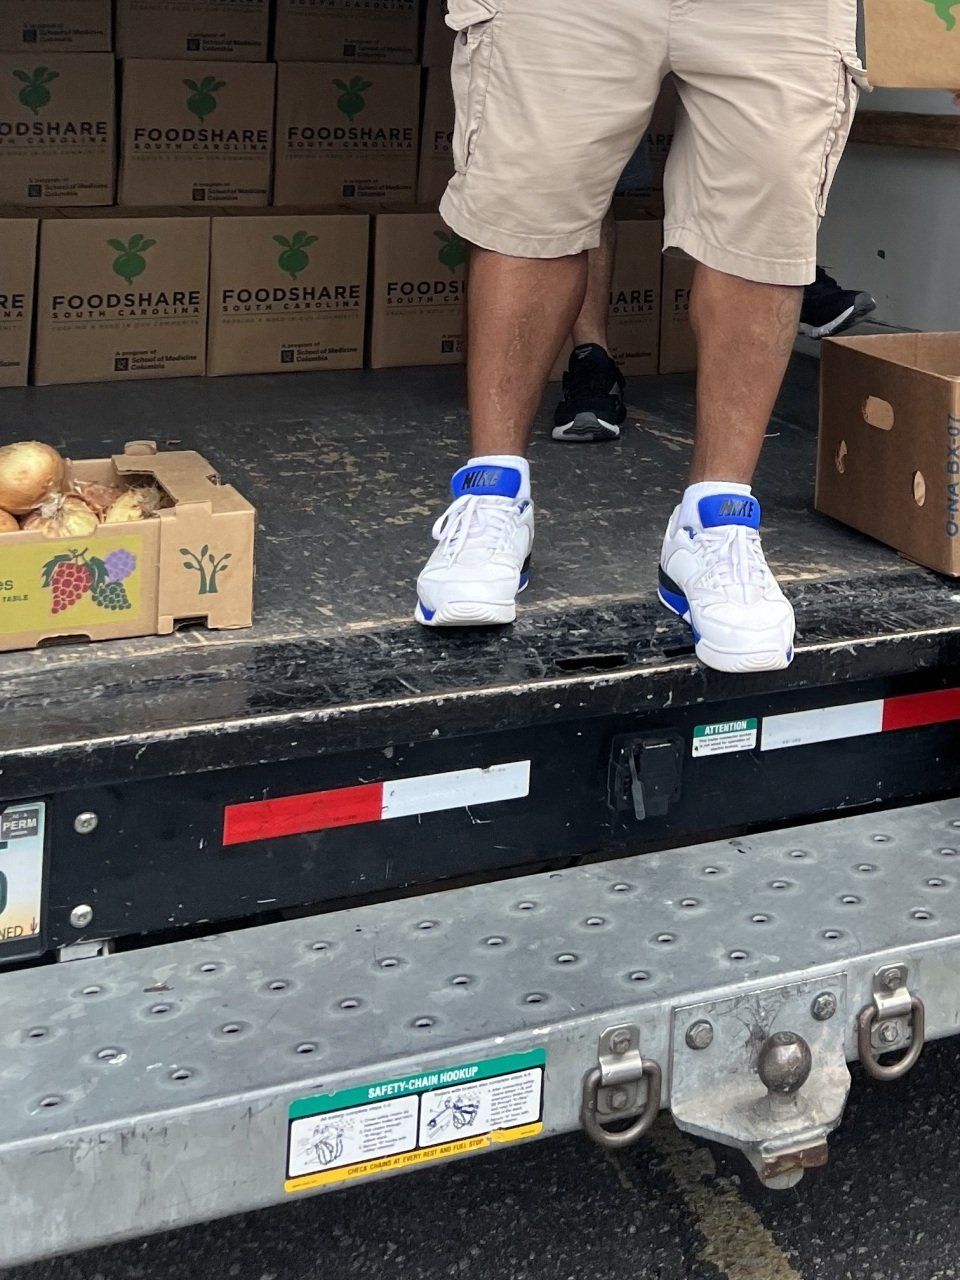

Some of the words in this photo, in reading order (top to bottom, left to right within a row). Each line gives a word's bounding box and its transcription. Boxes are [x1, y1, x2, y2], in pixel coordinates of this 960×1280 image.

[134, 128, 268, 143] FOODSHARE
[288, 127, 413, 141] FOODSHARE
[52, 291, 200, 310] FOODSHARE
[222, 285, 360, 303] FOODSHARE
[387, 296, 433, 304] SOUTH
[52, 310, 106, 318] SOUTH
[118, 307, 200, 317] CAROLINA
[222, 303, 272, 311] SOUTH
[283, 300, 360, 309] CAROLINA
[462, 470, 500, 490] NIKE
[719, 499, 754, 518] NIKE
[704, 720, 747, 735] ATTENTION
[2, 817, 37, 831] PERM
[368, 1075, 439, 1099] SAFETY-CHAIN
[439, 1066, 479, 1083] HOOKUP
[347, 1166, 367, 1176] CHECK
[370, 1160, 391, 1170] CHAINS
[402, 1154, 421, 1163] EVERY
[423, 1149, 437, 1158] REST
[440, 1146, 451, 1154] AND
[453, 1143, 467, 1151] FUEL
[468, 1139, 484, 1148] STOP
